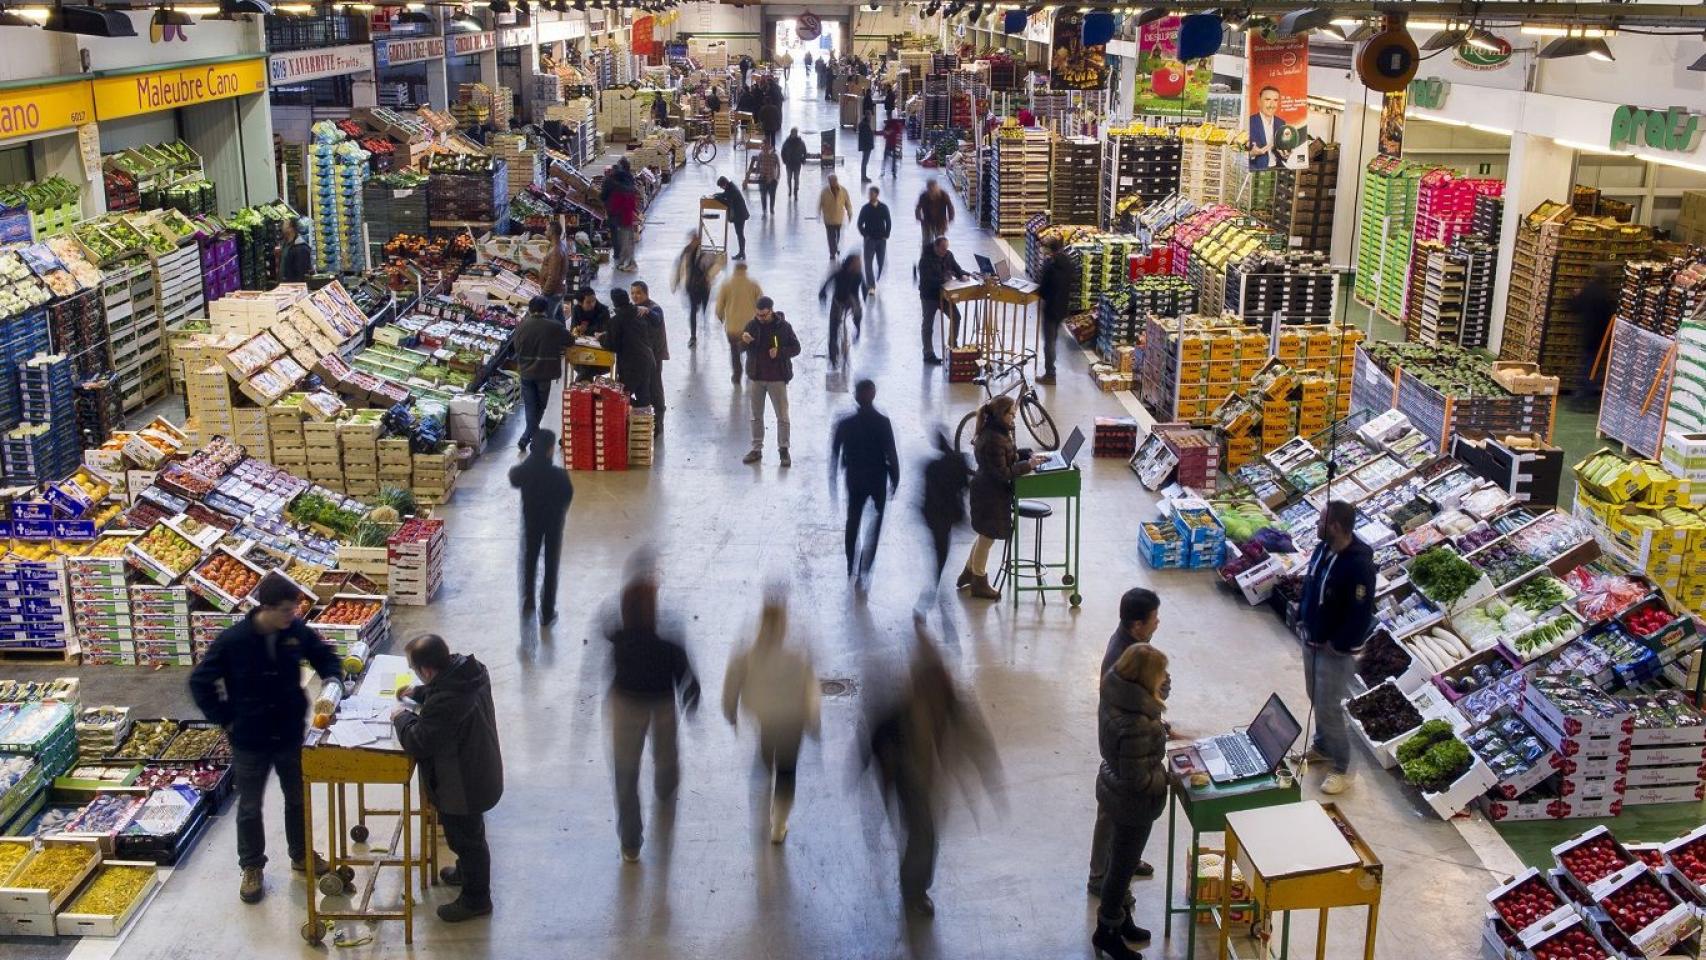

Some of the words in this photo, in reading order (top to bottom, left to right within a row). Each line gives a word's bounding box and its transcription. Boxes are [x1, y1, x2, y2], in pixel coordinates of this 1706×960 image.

[288, 54, 336, 77] NAVARRETE
[136, 72, 204, 109] Maleubre
[206, 66, 239, 97] Cano
[0, 103, 40, 132] ano
[1609, 104, 1702, 153] prats
